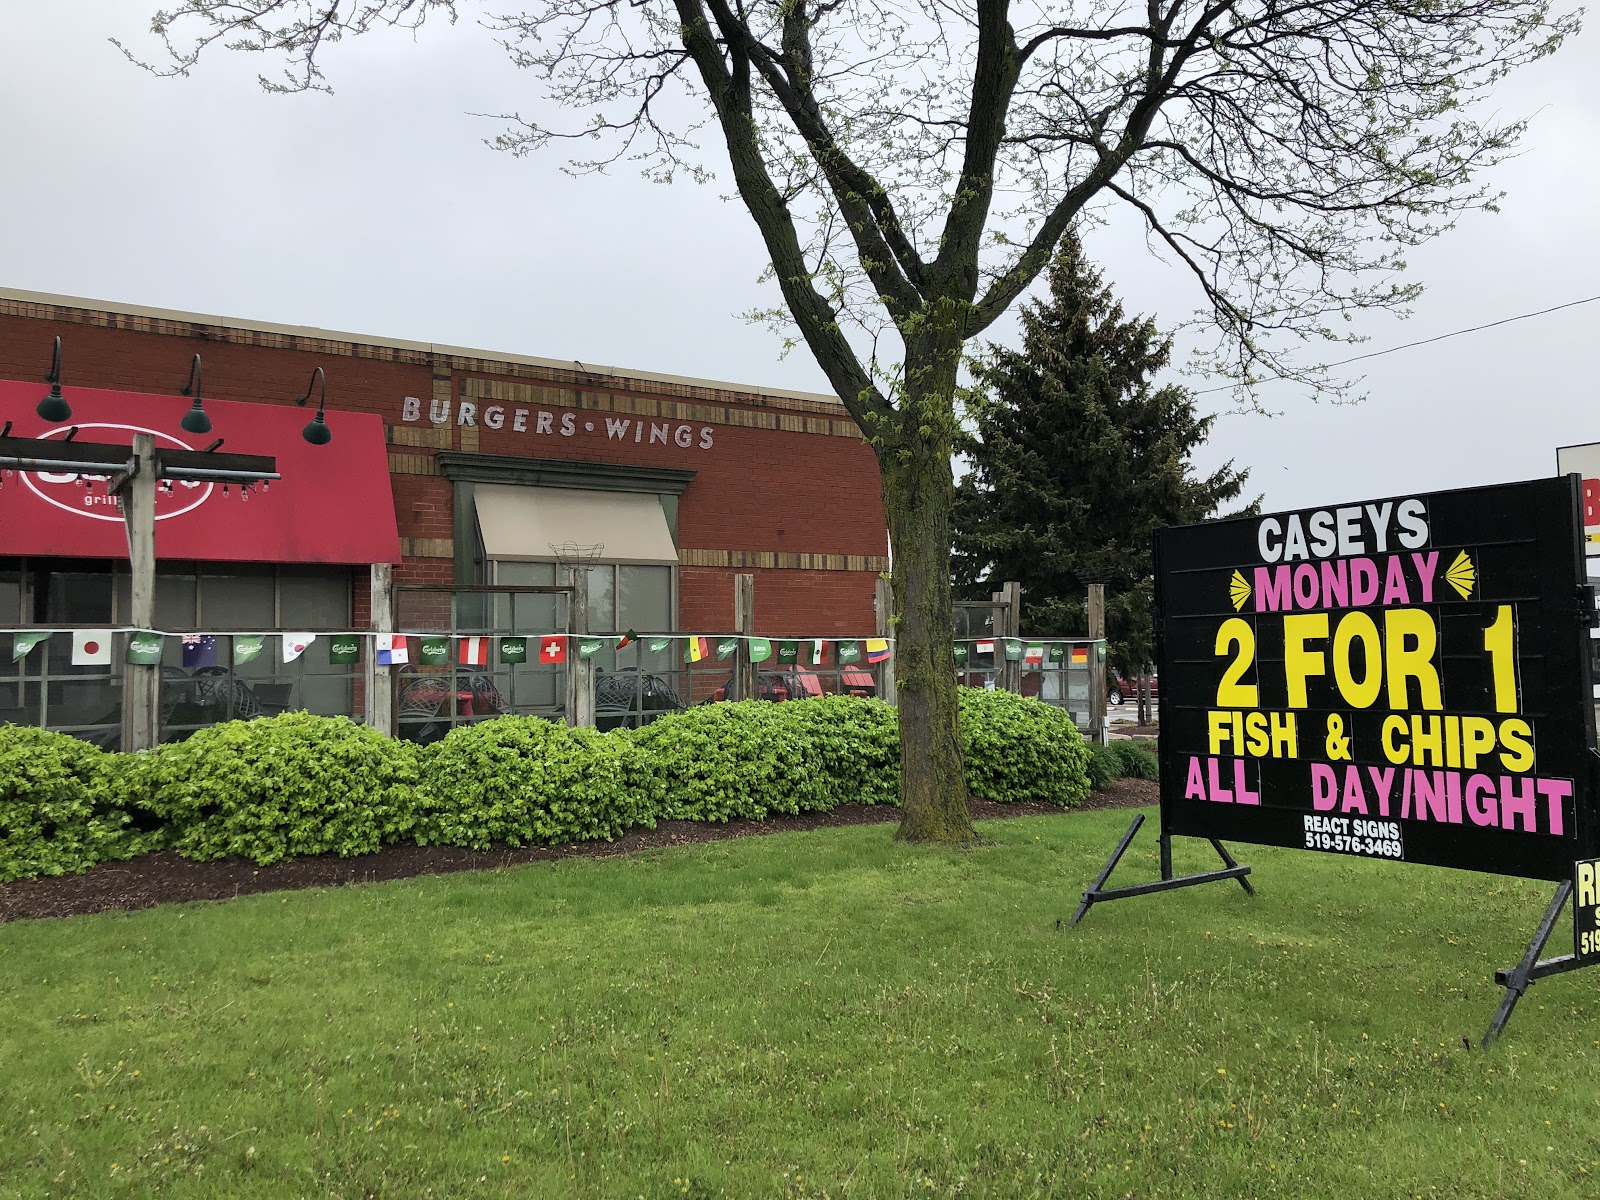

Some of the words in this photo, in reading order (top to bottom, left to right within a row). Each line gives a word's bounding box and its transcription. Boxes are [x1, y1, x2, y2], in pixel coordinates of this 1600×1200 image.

[402, 396, 576, 437] BURGERS
[605, 417, 714, 450] WINGS
[85, 495, 117, 506] grill
[1258, 499, 1429, 563] CASEYS
[1254, 551, 1440, 612] MONDAY
[422, 645, 446, 655] Carlsberg
[1214, 617, 1259, 708] 2
[1283, 608, 1444, 711] FOR
[1484, 604, 1518, 713] 1
[1207, 711, 1298, 759] FISH
[1325, 712, 1352, 761] &
[1381, 715, 1535, 773] CHIPS
[1185, 756, 1260, 806] ALL
[1311, 763, 1573, 836] DAY/NIGHT
[1303, 814, 1350, 835] REACT
[1353, 819, 1400, 841] SIGNS
[1305, 831, 1402, 857] 519-576-3469
